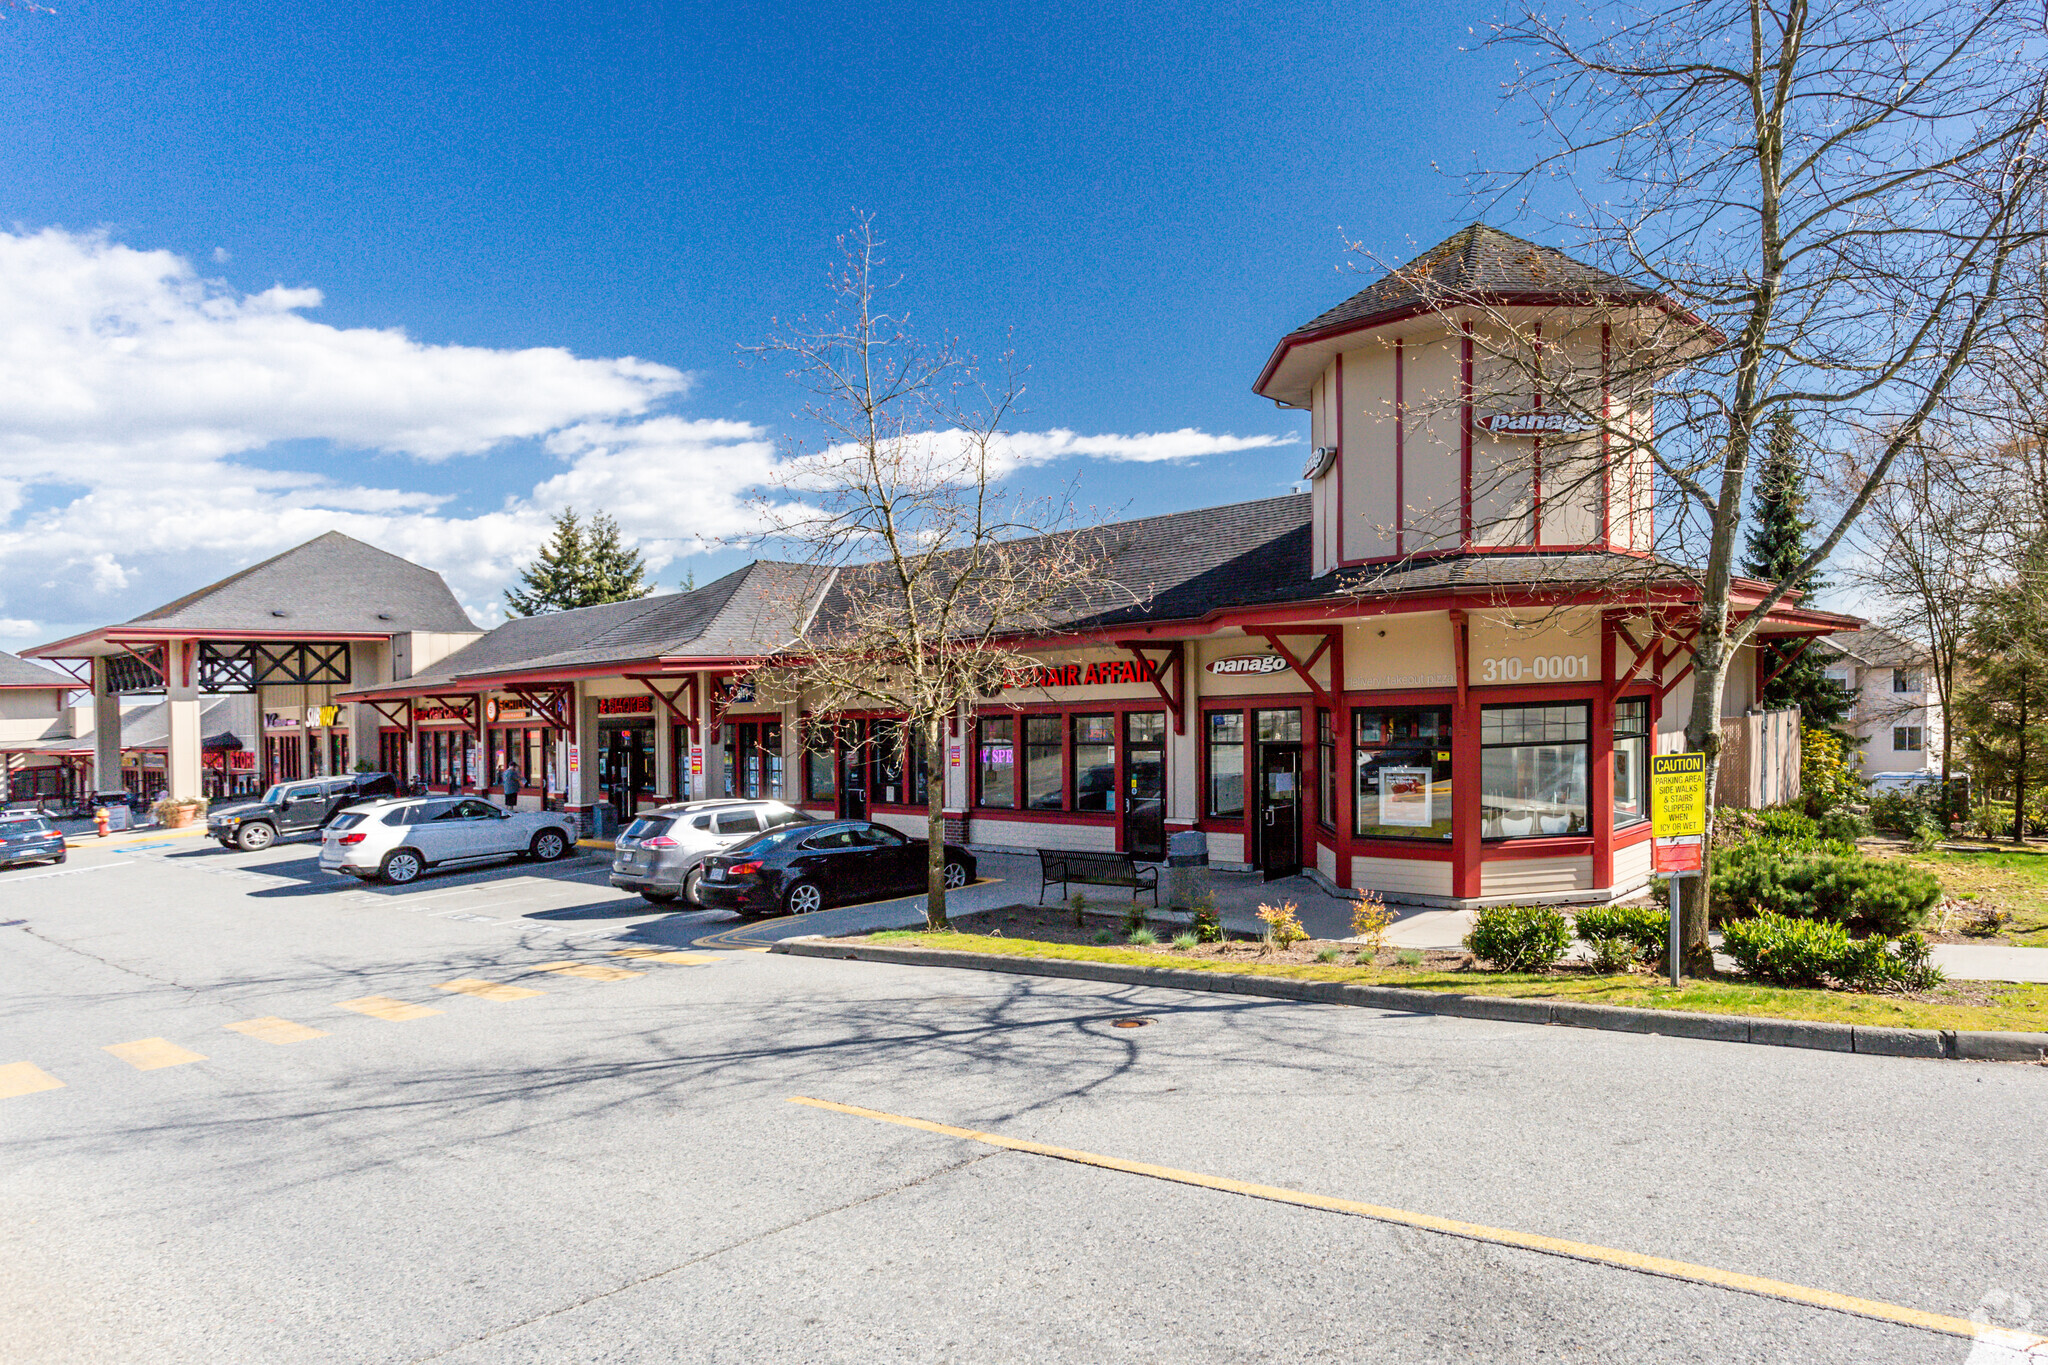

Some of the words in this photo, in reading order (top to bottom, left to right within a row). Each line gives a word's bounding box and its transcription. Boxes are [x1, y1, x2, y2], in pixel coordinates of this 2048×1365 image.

[1212, 656, 1287, 675] panago
[1482, 655, 1588, 681] 310-0001
[305, 705, 339, 728] SUBWAY
[1656, 758, 1700, 772] CAUTION
[1655, 776, 1683, 785] PARKING
[1684, 775, 1702, 783] AREA
[1659, 786, 1674, 794] SIDE
[1675, 785, 1698, 793] WALKS
[1670, 794, 1693, 803] STAIRS
[1664, 804, 1693, 813] SLIPPERY
[1668, 813, 1688, 821] WHEN
[1660, 824, 1671, 832] ICY
[1672, 823, 1681, 831] OR
[1683, 822, 1697, 830] WET
